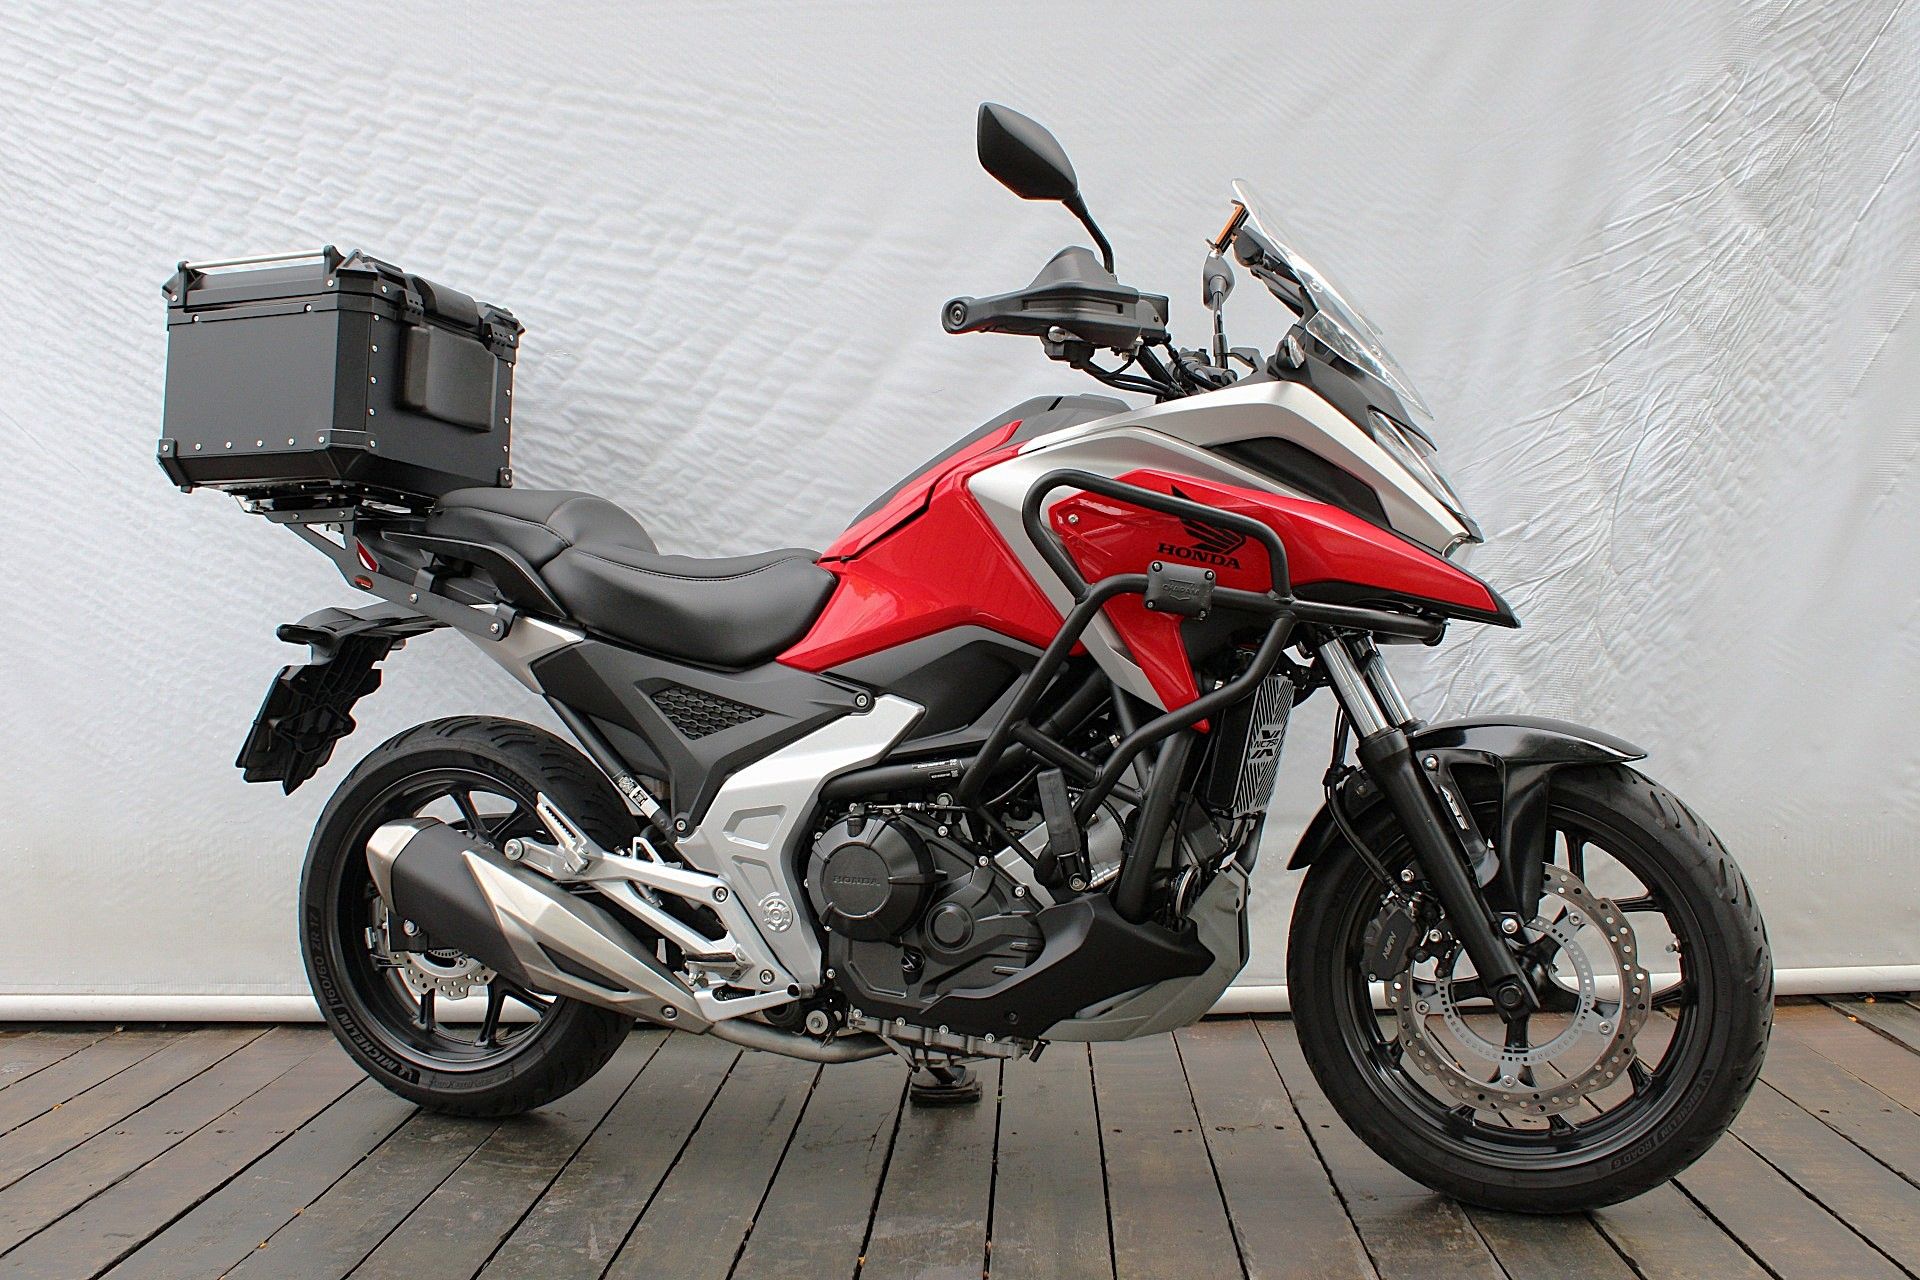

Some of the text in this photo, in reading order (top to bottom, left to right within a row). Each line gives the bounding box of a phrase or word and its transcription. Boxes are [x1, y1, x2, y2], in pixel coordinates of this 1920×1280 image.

[1158, 542, 1241, 569] HONDA
[832, 875, 881, 888] HONDA
[338, 1012, 399, 1072] MICHELIN
[1624, 1136, 1653, 1162] ROAD
